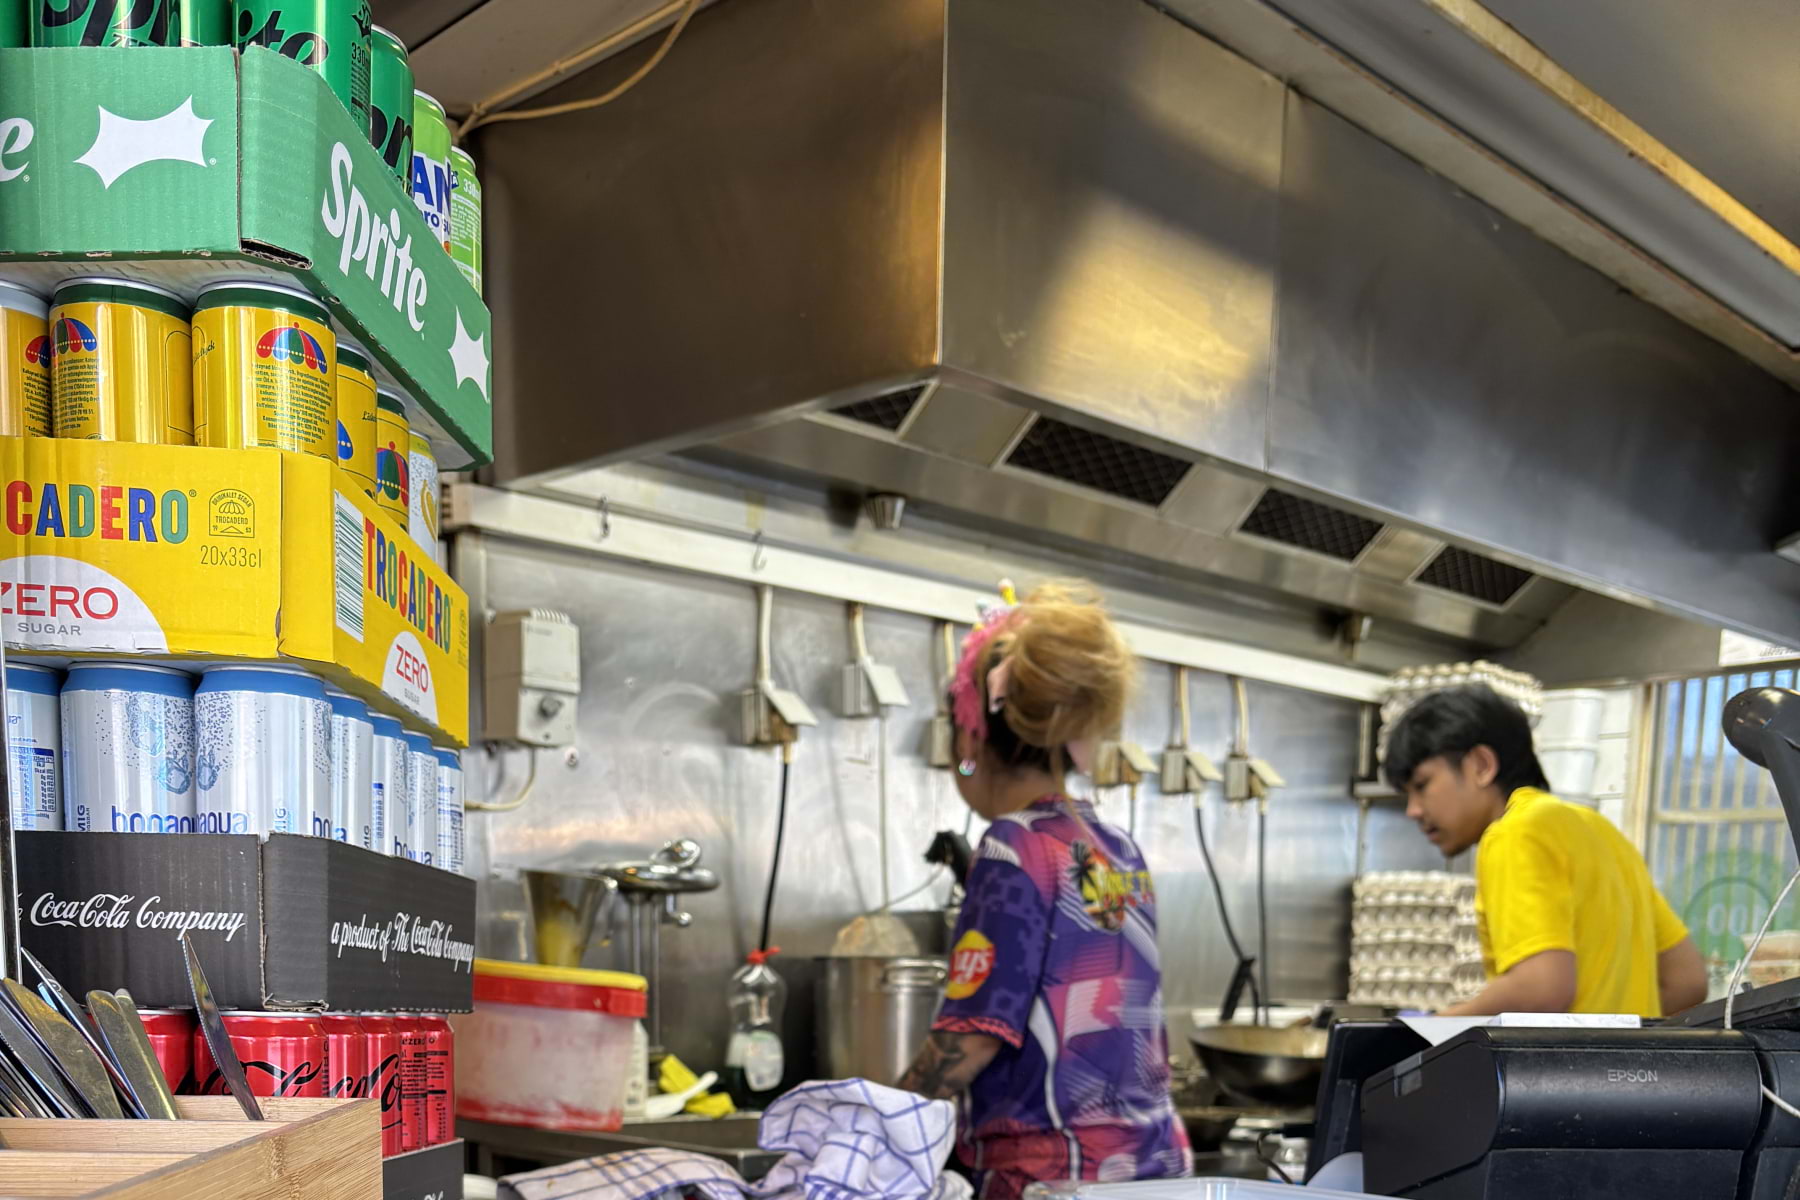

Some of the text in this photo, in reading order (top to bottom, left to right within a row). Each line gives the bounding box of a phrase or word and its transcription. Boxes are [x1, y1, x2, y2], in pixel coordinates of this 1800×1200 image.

[321, 141, 428, 332] Sprite
[215, 516, 248, 525] TROCADERO
[200, 545, 261, 568] 20x33cl
[365, 517, 451, 654] TROCADERO
[18, 622, 81, 636] SUGAR
[396, 644, 429, 693] ZERO
[30, 892, 135, 928] Coca-Cola
[136, 896, 246, 942] Company
[331, 912, 474, 974] a product of The Coca-Cola Company
[1608, 1069, 1658, 1082] EPSON
